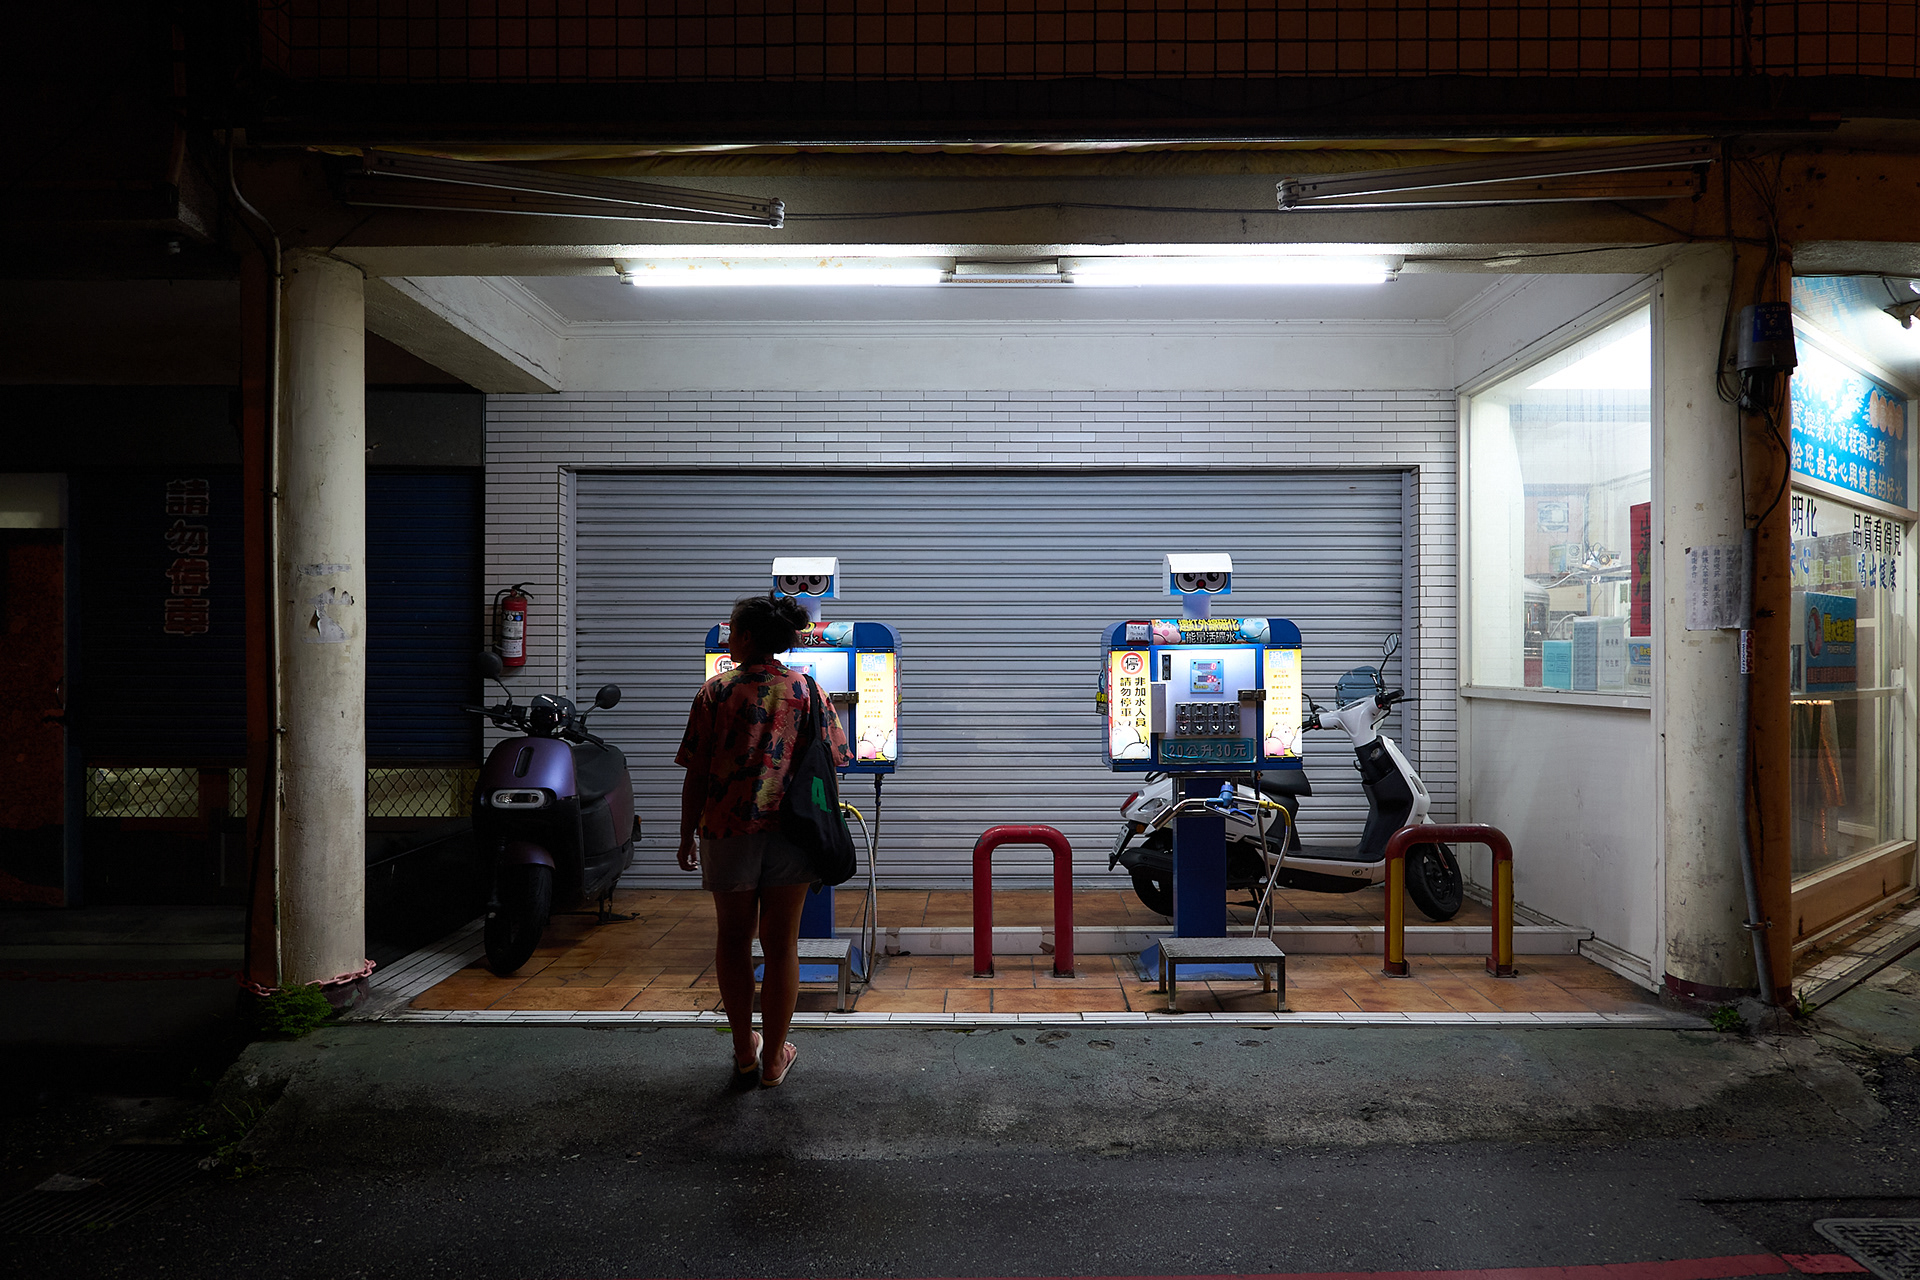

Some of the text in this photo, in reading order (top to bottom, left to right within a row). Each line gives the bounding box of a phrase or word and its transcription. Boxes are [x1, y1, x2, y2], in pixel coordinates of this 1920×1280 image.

[1791, 437, 1903, 503] 給您最安心與健康的好水
[1852, 512, 1902, 557] 品質看得見
[163, 478, 210, 637] 請勿停車
[1857, 553, 1898, 593] 喝出健康
[1125, 657, 1139, 671] 停
[1119, 677, 1132, 717] 請勿停車
[1134, 676, 1147, 728] 非加水人員
[1168, 743, 1247, 759] 20公升30元
